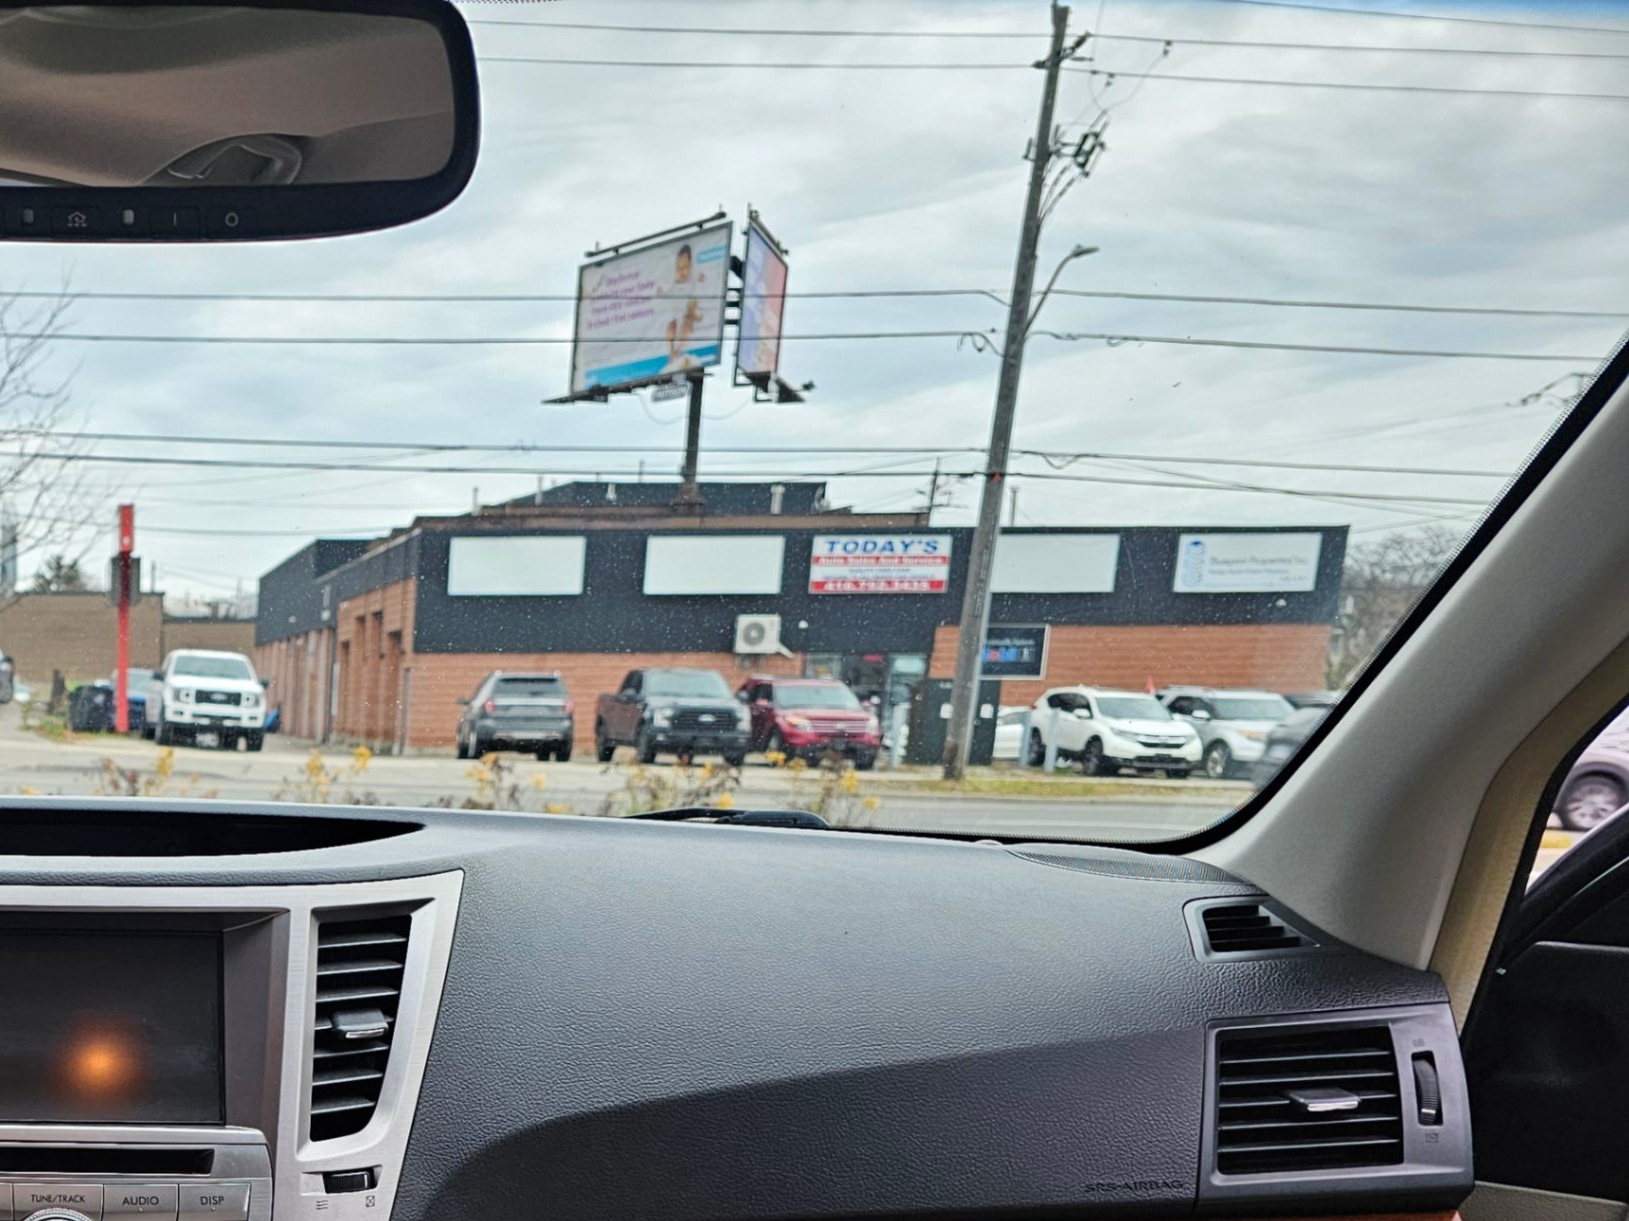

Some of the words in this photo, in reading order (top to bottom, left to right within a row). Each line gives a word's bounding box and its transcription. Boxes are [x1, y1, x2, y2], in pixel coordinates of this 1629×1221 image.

[825, 540, 938, 553] TODAY'S
[30, 1193, 86, 1204] TUNE/TRACK
[122, 1196, 160, 1206] AUDIO
[199, 1195, 225, 1206] DISP
